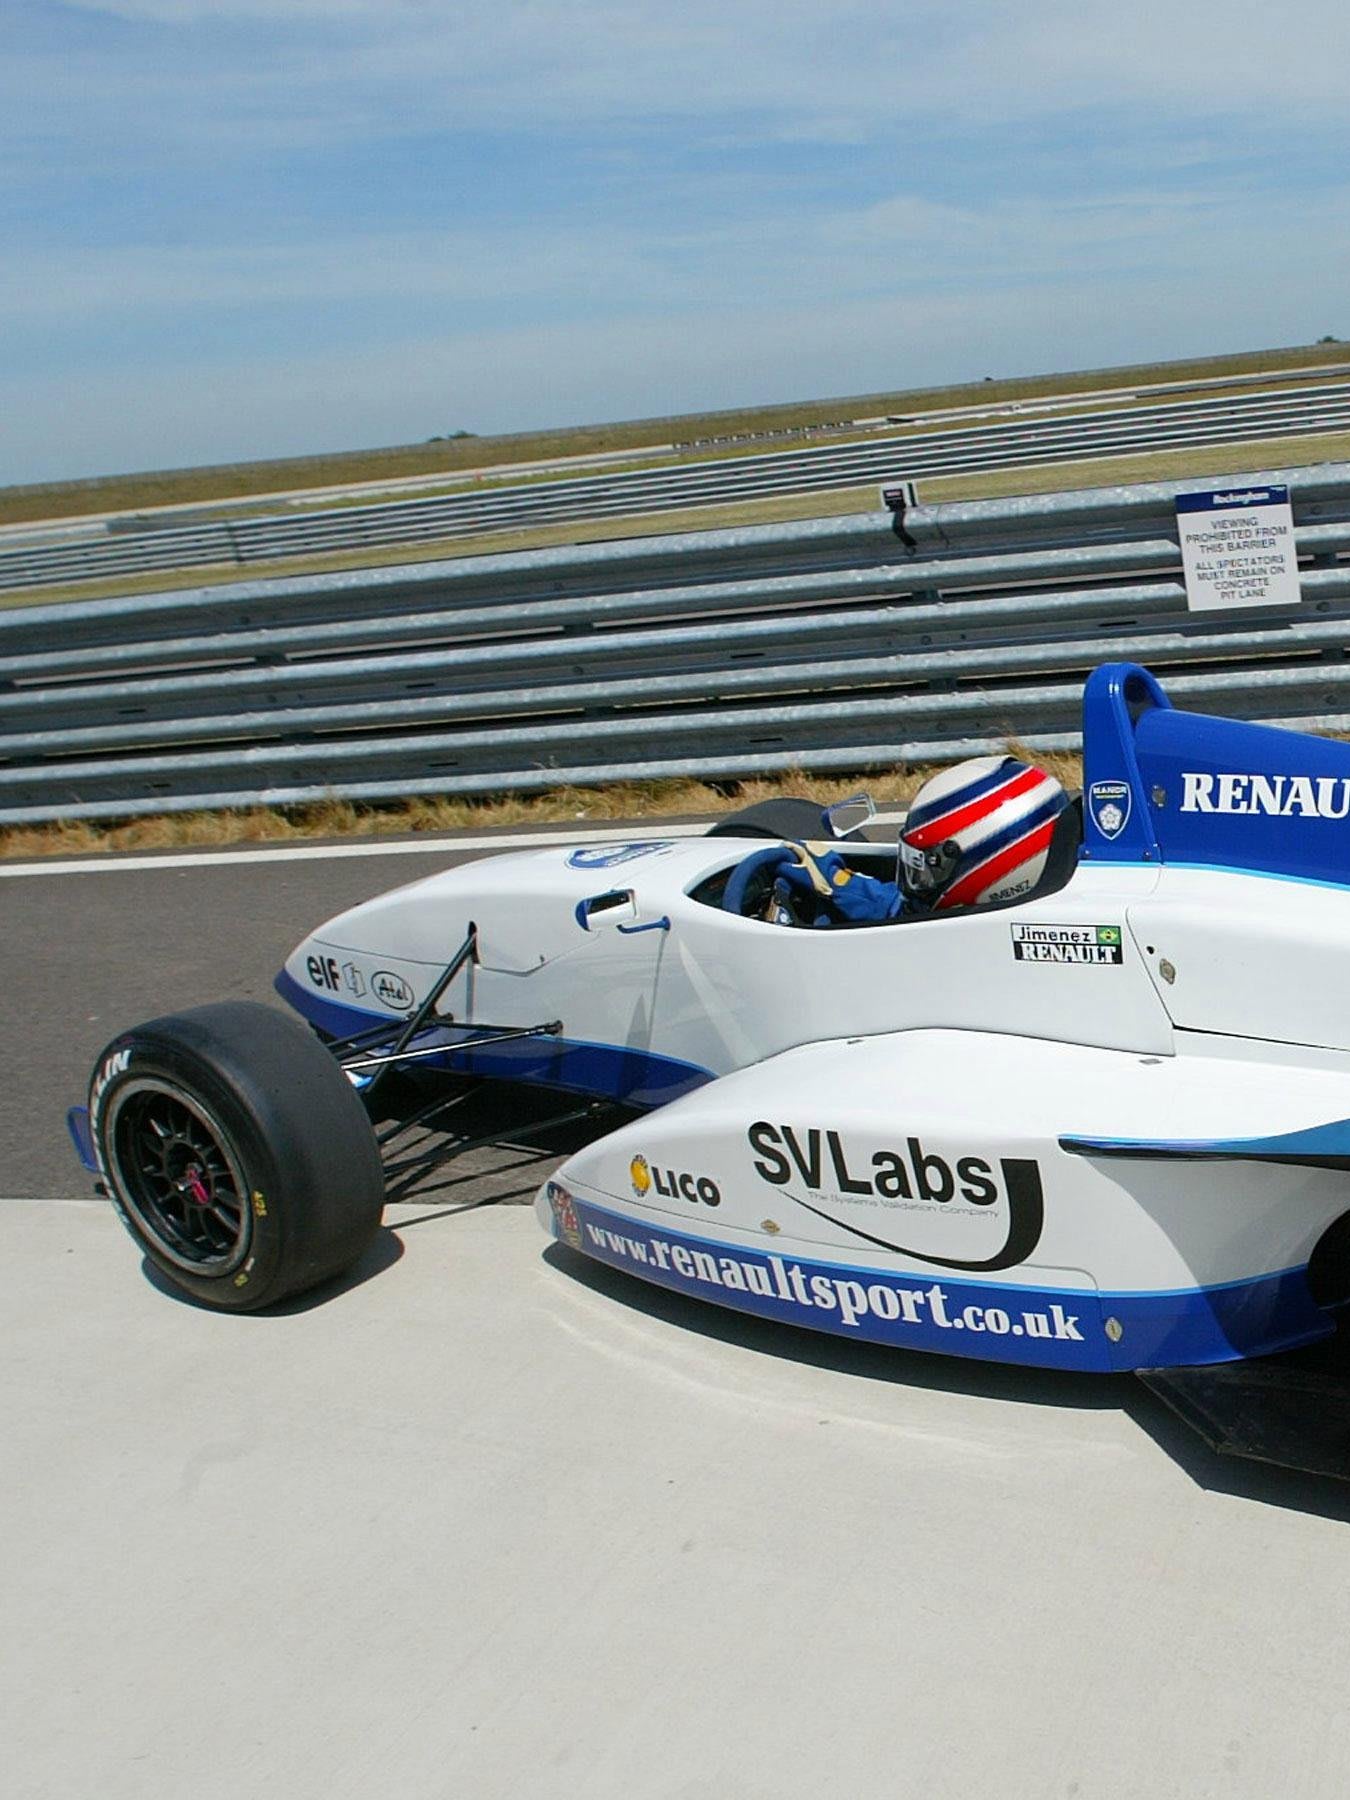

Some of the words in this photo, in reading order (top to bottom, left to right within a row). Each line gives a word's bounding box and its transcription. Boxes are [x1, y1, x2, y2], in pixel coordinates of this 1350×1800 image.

[1211, 517, 1258, 529] VIEWING
[1186, 528, 1252, 544] PROHIBITED
[1255, 526, 1288, 537] FROM
[1199, 543, 1225, 554] THIS
[1227, 538, 1277, 552] BARRIER
[1195, 561, 1214, 571] ALL
[1217, 555, 1285, 569] SPECTATORS
[1228, 567, 1268, 579] REMAIN
[1270, 566, 1286, 575] ON
[1214, 577, 1270, 590] CONCRETE
[1221, 590, 1236, 600] PIT
[1238, 588, 1267, 599] LANE
[1018, 925, 1092, 944] Jimenez
[1021, 943, 1117, 965] RENAULT
[307, 955, 340, 991] elf
[748, 1120, 999, 1206] SVLabs
[651, 1166, 721, 1207] LICO
[586, 1219, 1086, 1341] www.renaultsport.co.uk
